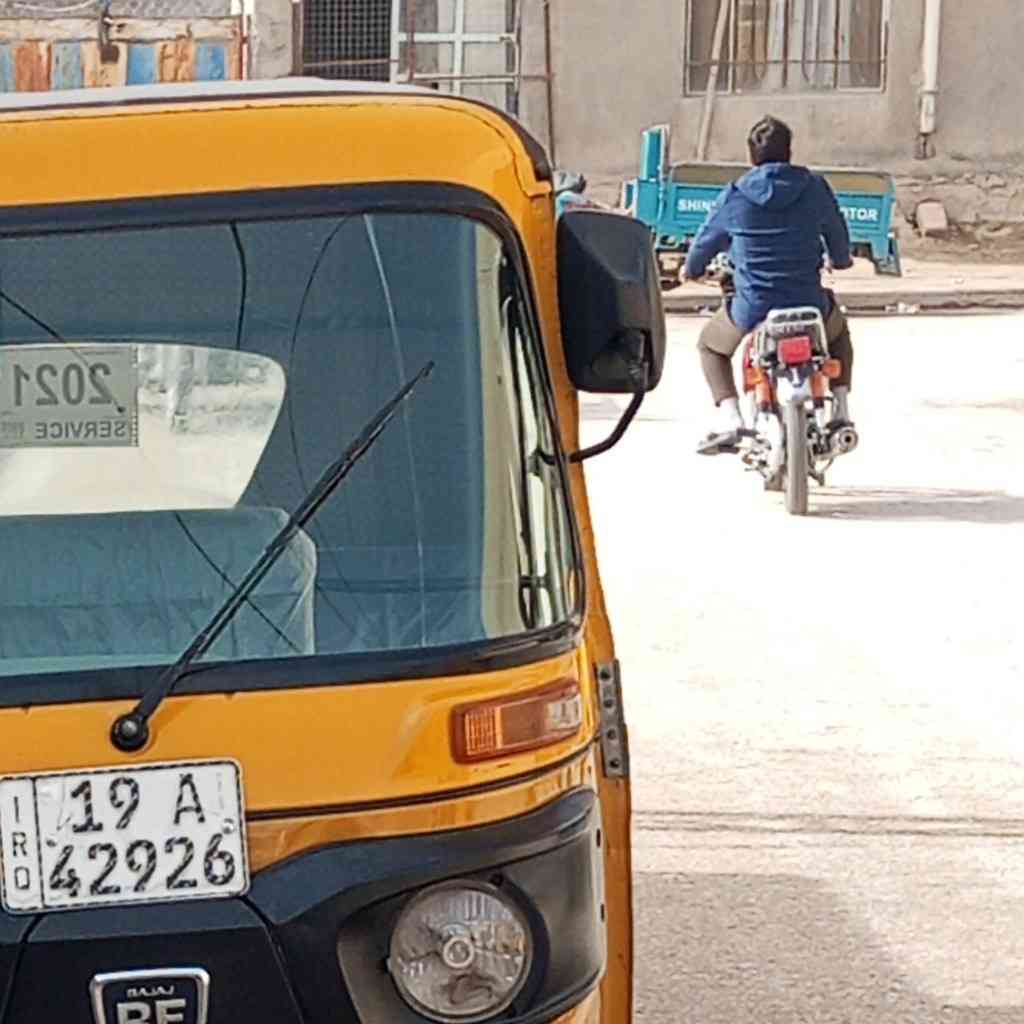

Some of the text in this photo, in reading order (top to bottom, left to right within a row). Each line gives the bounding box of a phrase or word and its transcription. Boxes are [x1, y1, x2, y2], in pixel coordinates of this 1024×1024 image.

[678, 199, 878, 221] SHIN OTOR
[70, 773, 205, 833] 19 A
[49, 833, 236, 897] 42926
